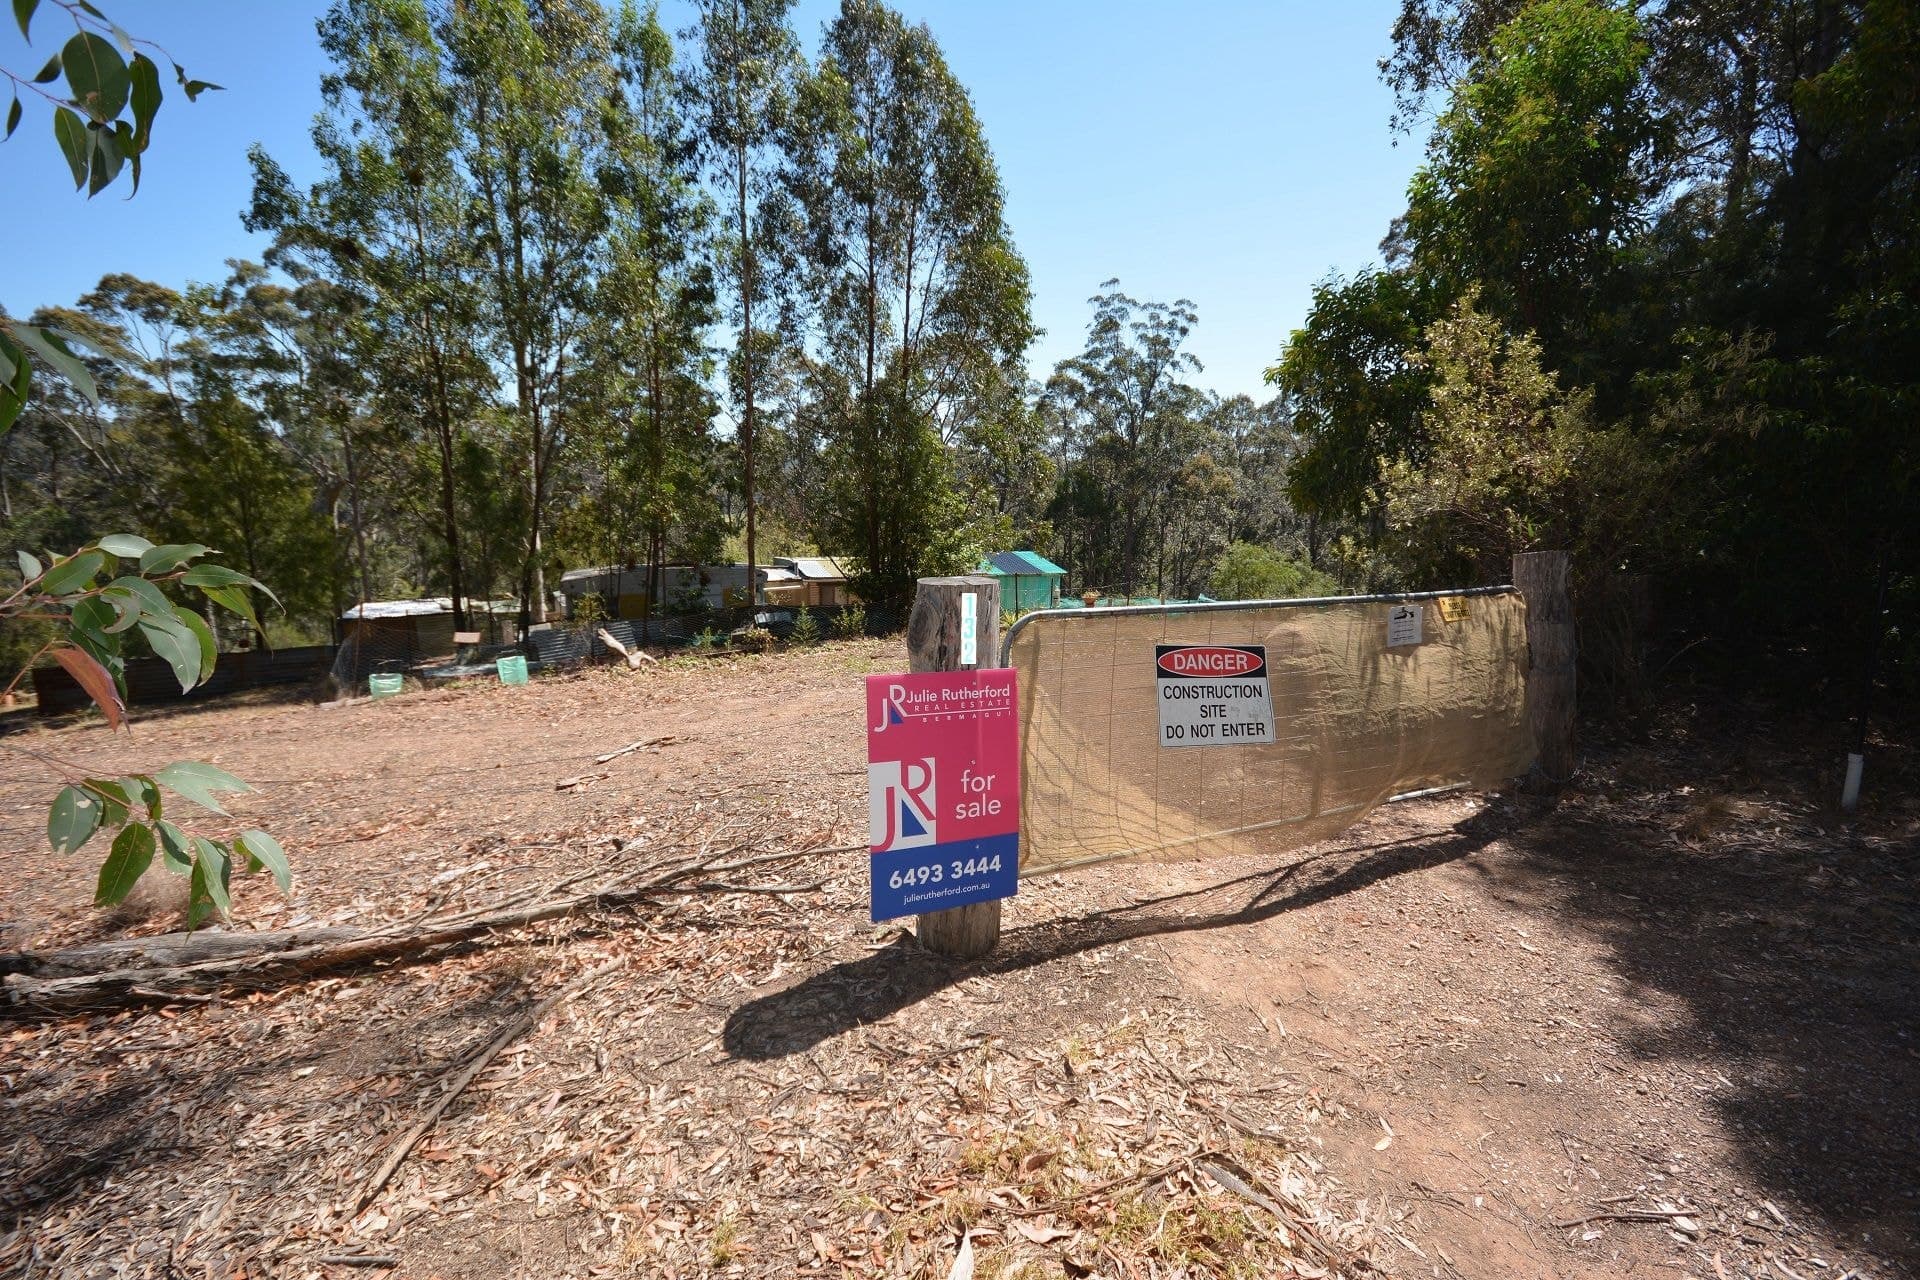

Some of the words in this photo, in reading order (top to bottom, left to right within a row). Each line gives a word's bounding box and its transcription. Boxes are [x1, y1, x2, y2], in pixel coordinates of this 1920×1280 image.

[1174, 653, 1248, 671] DANGER
[907, 689, 938, 704] Julie
[942, 684, 1010, 701] Rutherford
[1163, 684, 1263, 700] CONSTRUCTION
[914, 703, 949, 712] REAL
[961, 698, 1011, 709] ESTATE
[1200, 704, 1227, 718] SITE
[1166, 725, 1184, 739] DO
[1191, 724, 1215, 738] NOT
[1222, 722, 1265, 737] ENTER
[960, 769, 996, 794] for
[955, 793, 1002, 820] sale
[889, 863, 944, 890] 6493
[951, 854, 1002, 879] 3444
[903, 882, 991, 906] julierutherford.com.au
